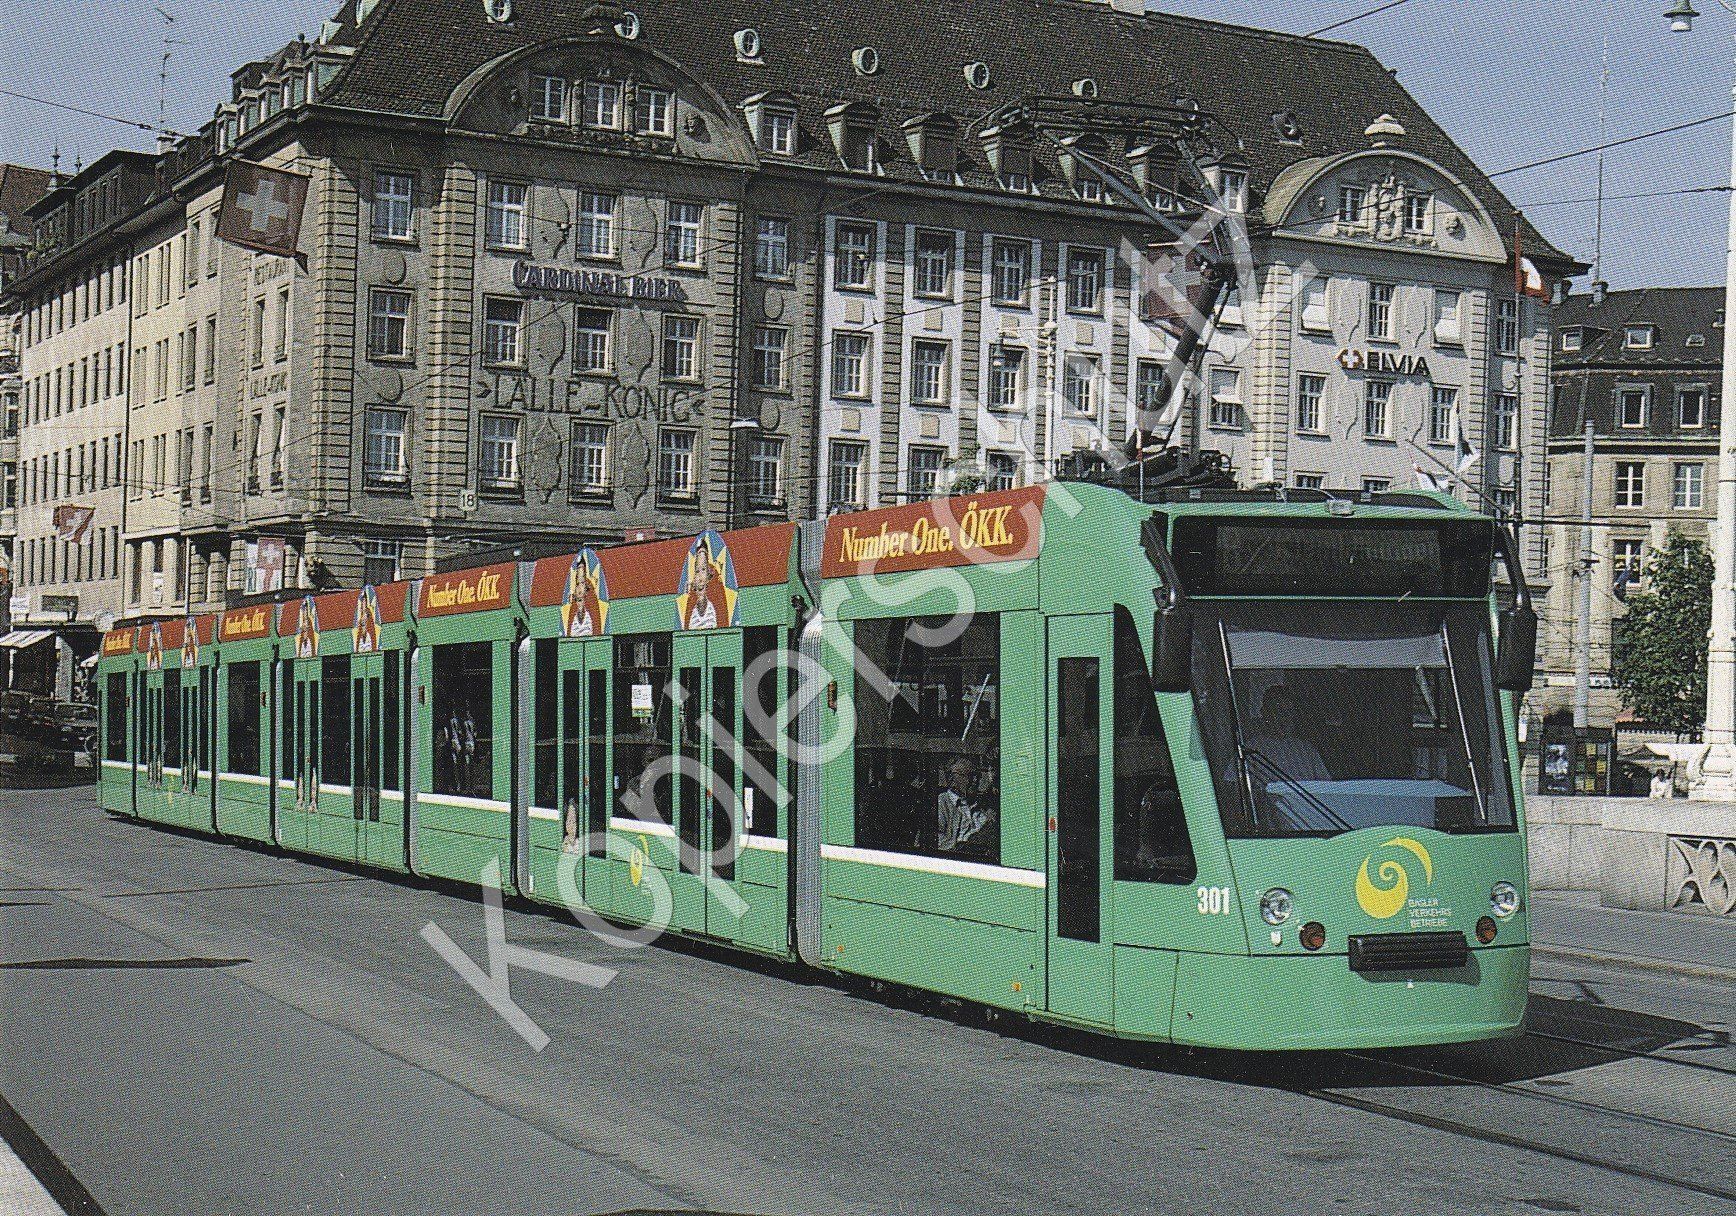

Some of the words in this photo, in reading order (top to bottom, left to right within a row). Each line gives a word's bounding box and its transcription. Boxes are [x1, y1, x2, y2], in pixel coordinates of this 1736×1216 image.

[511, 258, 627, 296] CARDINAL
[629, 274, 688, 301] BIER
[1364, 351, 1431, 376] ELVIA
[462, 494, 474, 507] 18
[838, 521, 908, 563] Number
[911, 517, 953, 556] One.
[959, 501, 1014, 550] ÖKK.
[1197, 886, 1230, 915] 301
